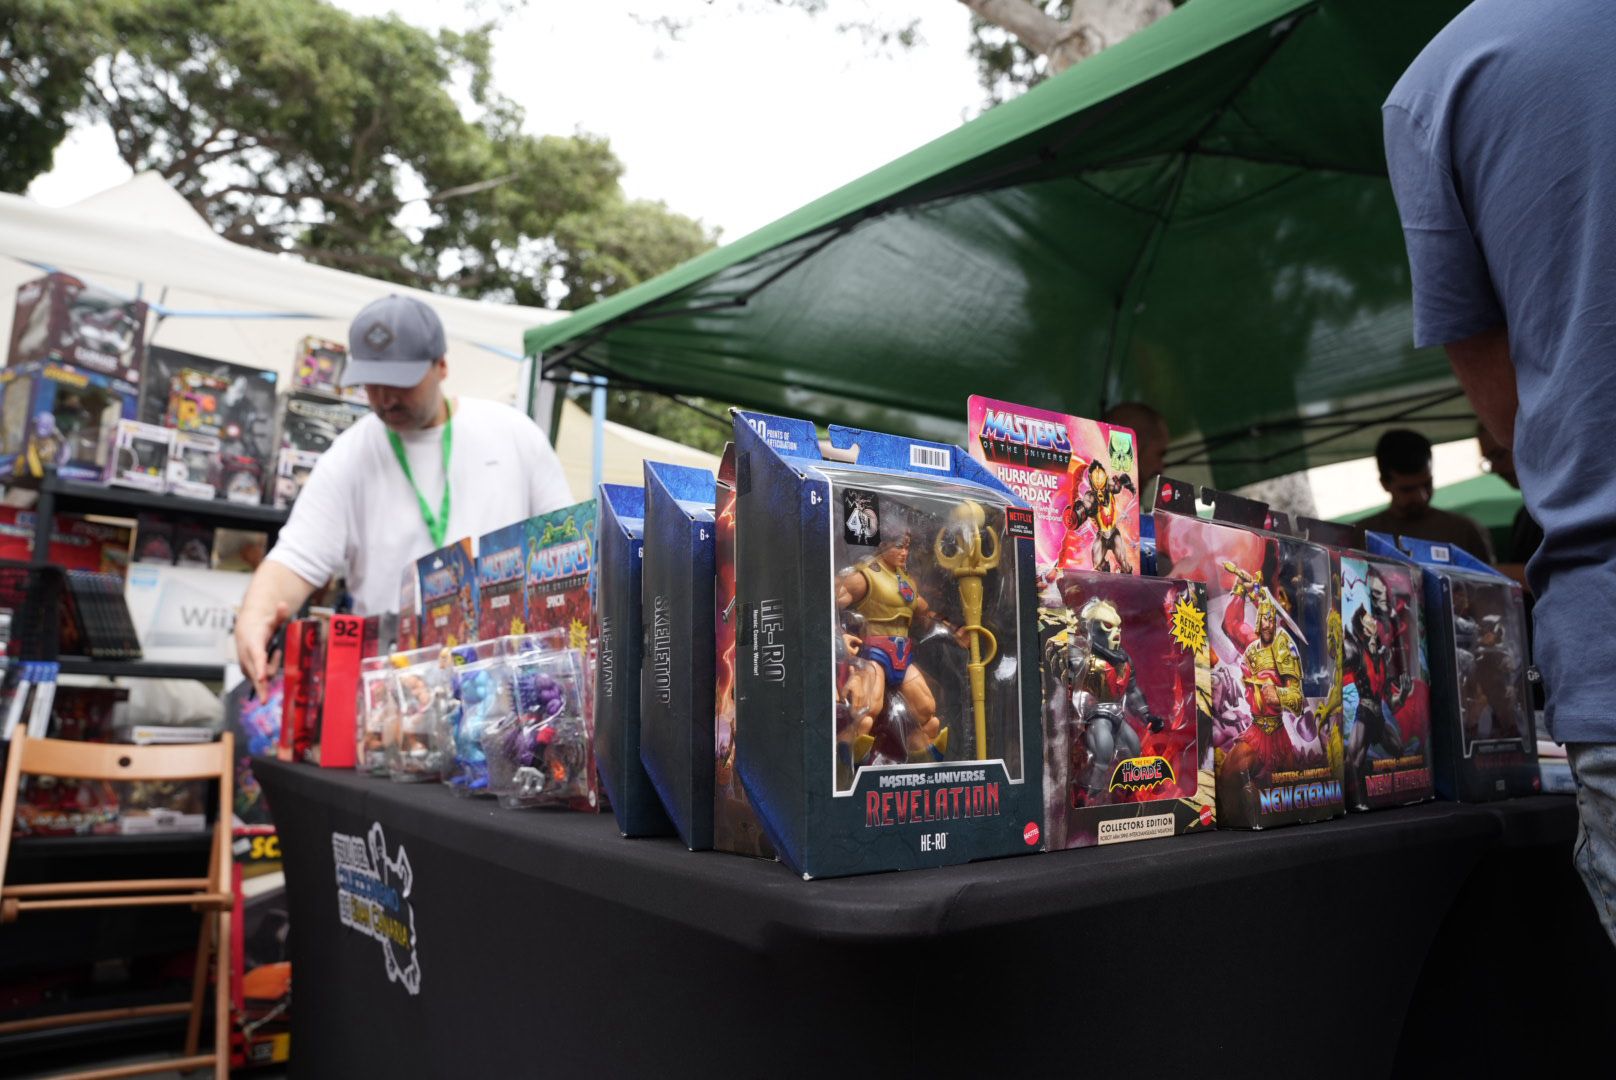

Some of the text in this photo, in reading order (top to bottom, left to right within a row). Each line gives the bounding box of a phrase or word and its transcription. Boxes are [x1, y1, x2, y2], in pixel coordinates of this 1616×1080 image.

[767, 430, 783, 439] POINTS
[981, 408, 1072, 453] MASTERS
[983, 440, 1069, 463] OF THE UNIVERSE
[997, 466, 1058, 490] HURRICANE
[810, 490, 822, 505] 6+
[1009, 511, 1033, 524] NETFLIX
[700, 528, 710, 541] 6+
[180, 605, 227, 629] Wii
[1180, 615, 1201, 634] RETRO
[334, 620, 359, 637] 92
[1180, 627, 1198, 644] PLAY!
[654, 595, 671, 704] SKELETOR
[761, 598, 785, 682] HE-RO
[879, 773, 926, 788] MASTERS
[934, 769, 986, 784] UNIVERSE
[1122, 757, 1163, 783] HORDE
[1365, 773, 1392, 797] NEW
[865, 782, 1001, 828] REVELATION
[1258, 779, 1343, 814] NEW ETERNIA
[1100, 817, 1173, 833] COLLECTORS EDITION
[920, 832, 947, 852] HE-RO
